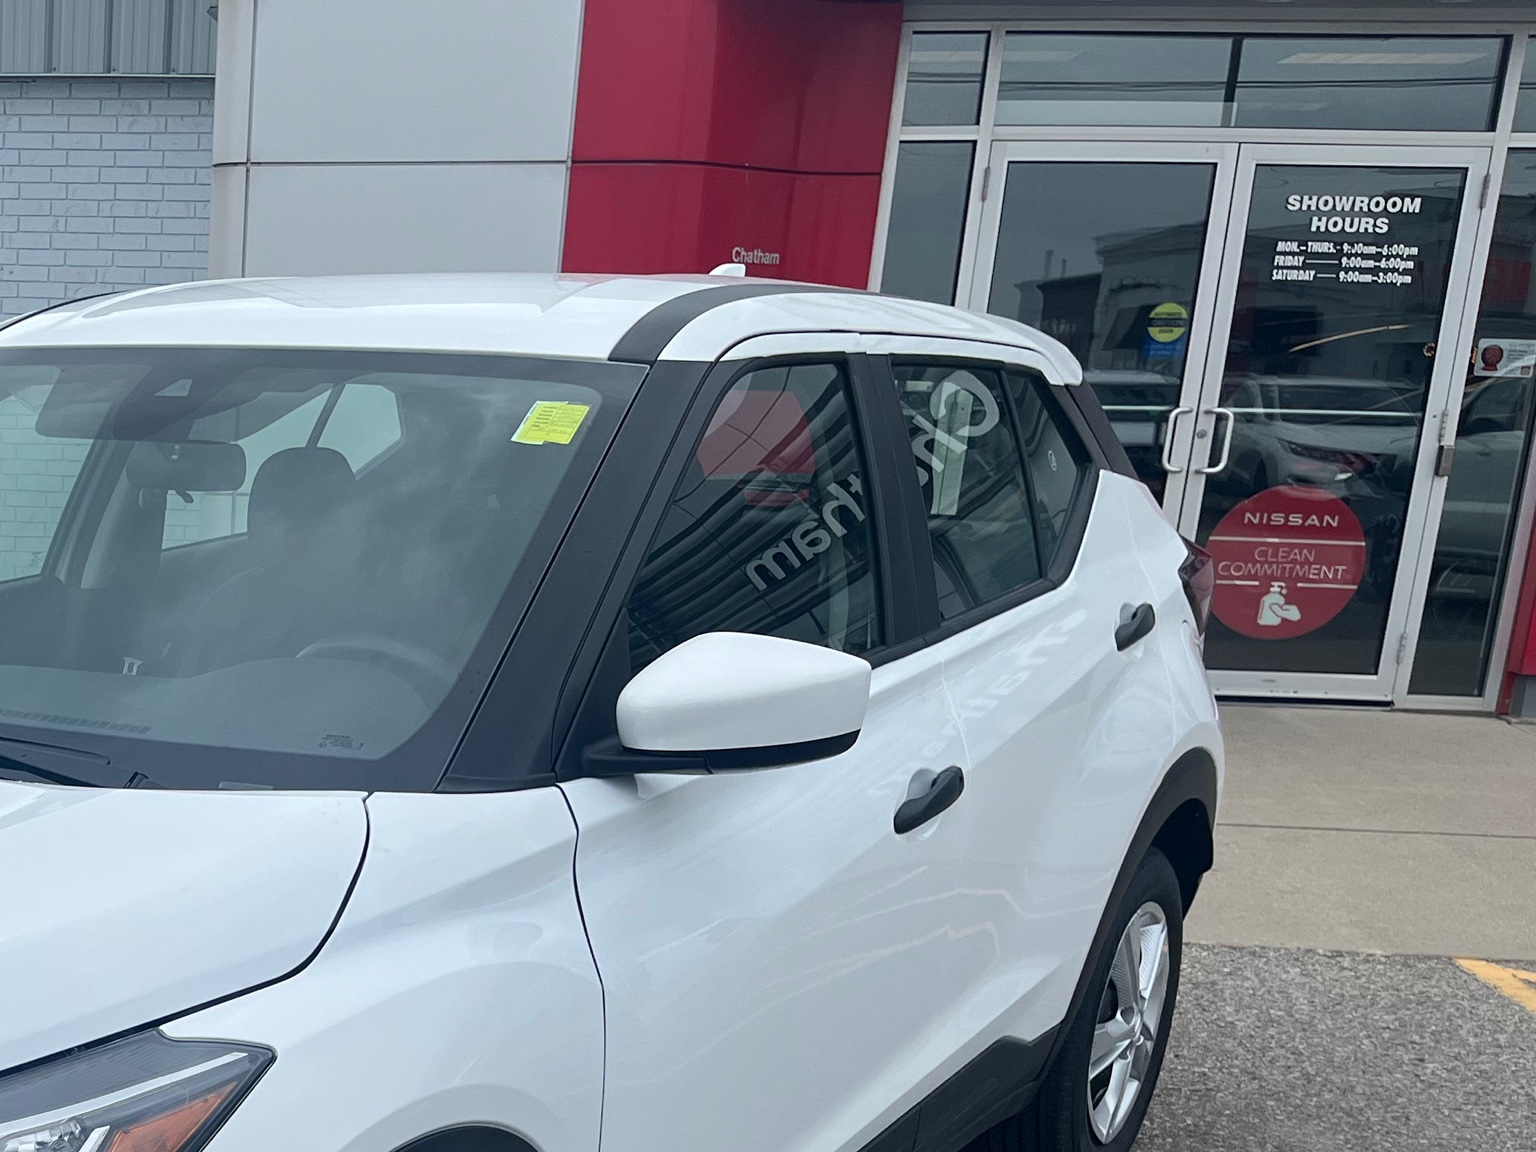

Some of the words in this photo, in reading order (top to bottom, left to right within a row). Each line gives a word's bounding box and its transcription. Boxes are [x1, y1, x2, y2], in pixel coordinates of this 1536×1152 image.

[1286, 194, 1422, 214] SHOWROOM
[1310, 216, 1389, 234] HOURS
[732, 246, 779, 265] Chatham
[1274, 255, 1305, 266] FRIDAY
[1272, 269, 1315, 281] SATURDAY
[1244, 511, 1339, 528] NISSAN
[1254, 546, 1315, 562] CLEAN
[1217, 560, 1347, 580] COMMITMENT
